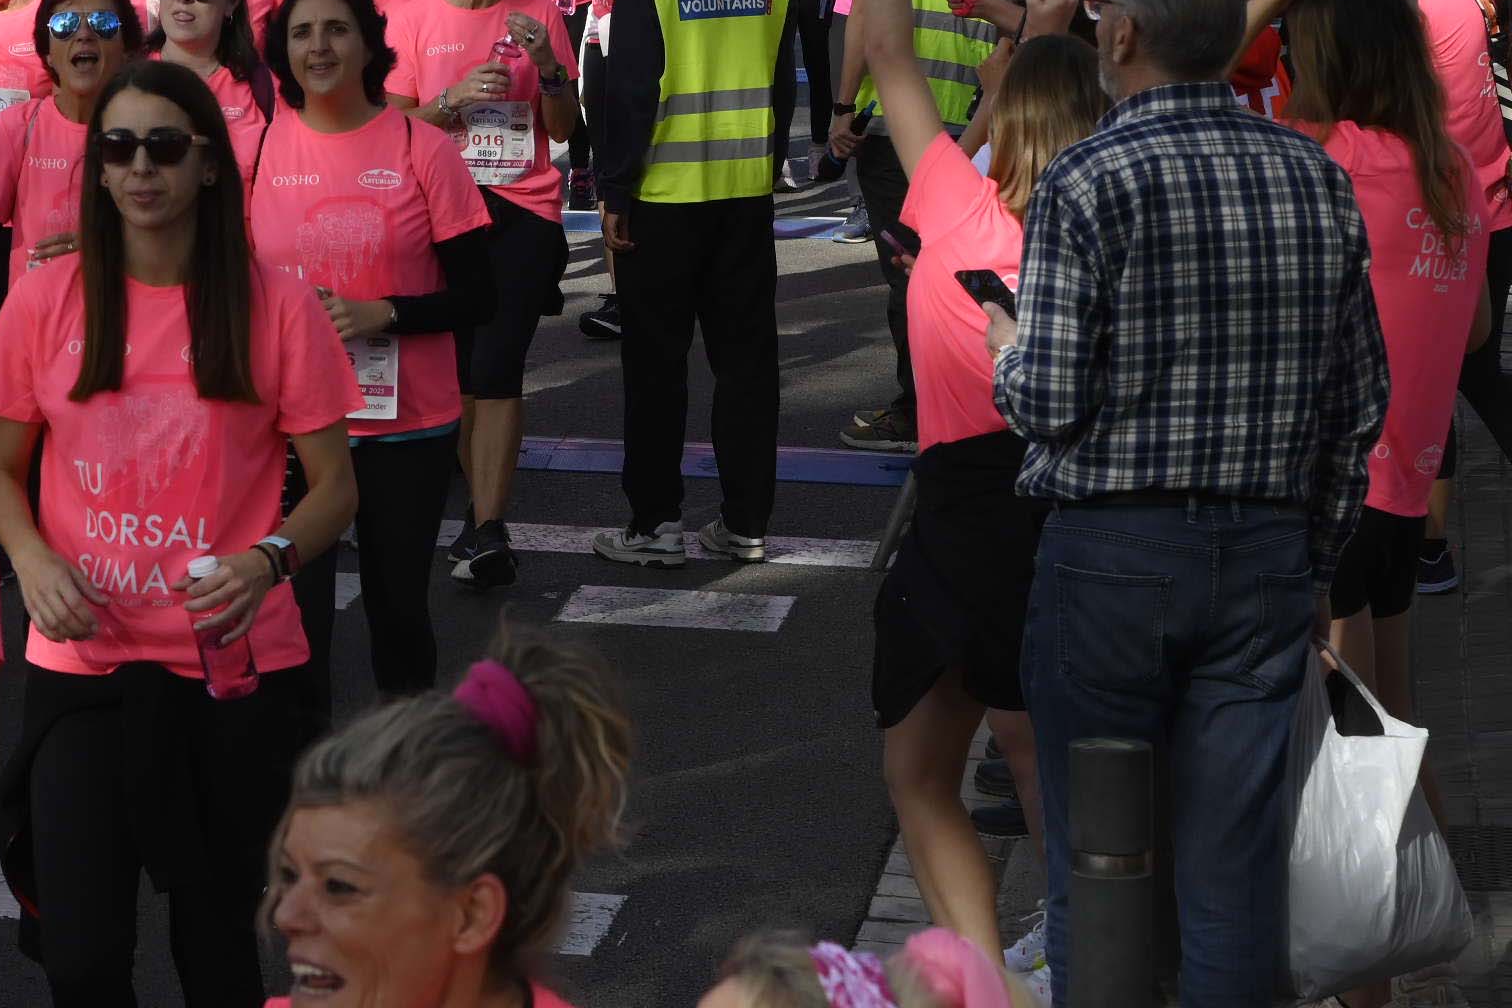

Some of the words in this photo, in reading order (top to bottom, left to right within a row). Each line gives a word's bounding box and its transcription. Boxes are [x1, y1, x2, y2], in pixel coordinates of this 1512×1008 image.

[426, 43, 465, 57] OYSHO
[472, 134, 505, 146] 016
[272, 173, 321, 187] OYSHO
[1408, 256, 1469, 281] MUJER
[74, 459, 103, 494] TU
[87, 507, 212, 551] DORSAL
[78, 553, 169, 595] SUMA
